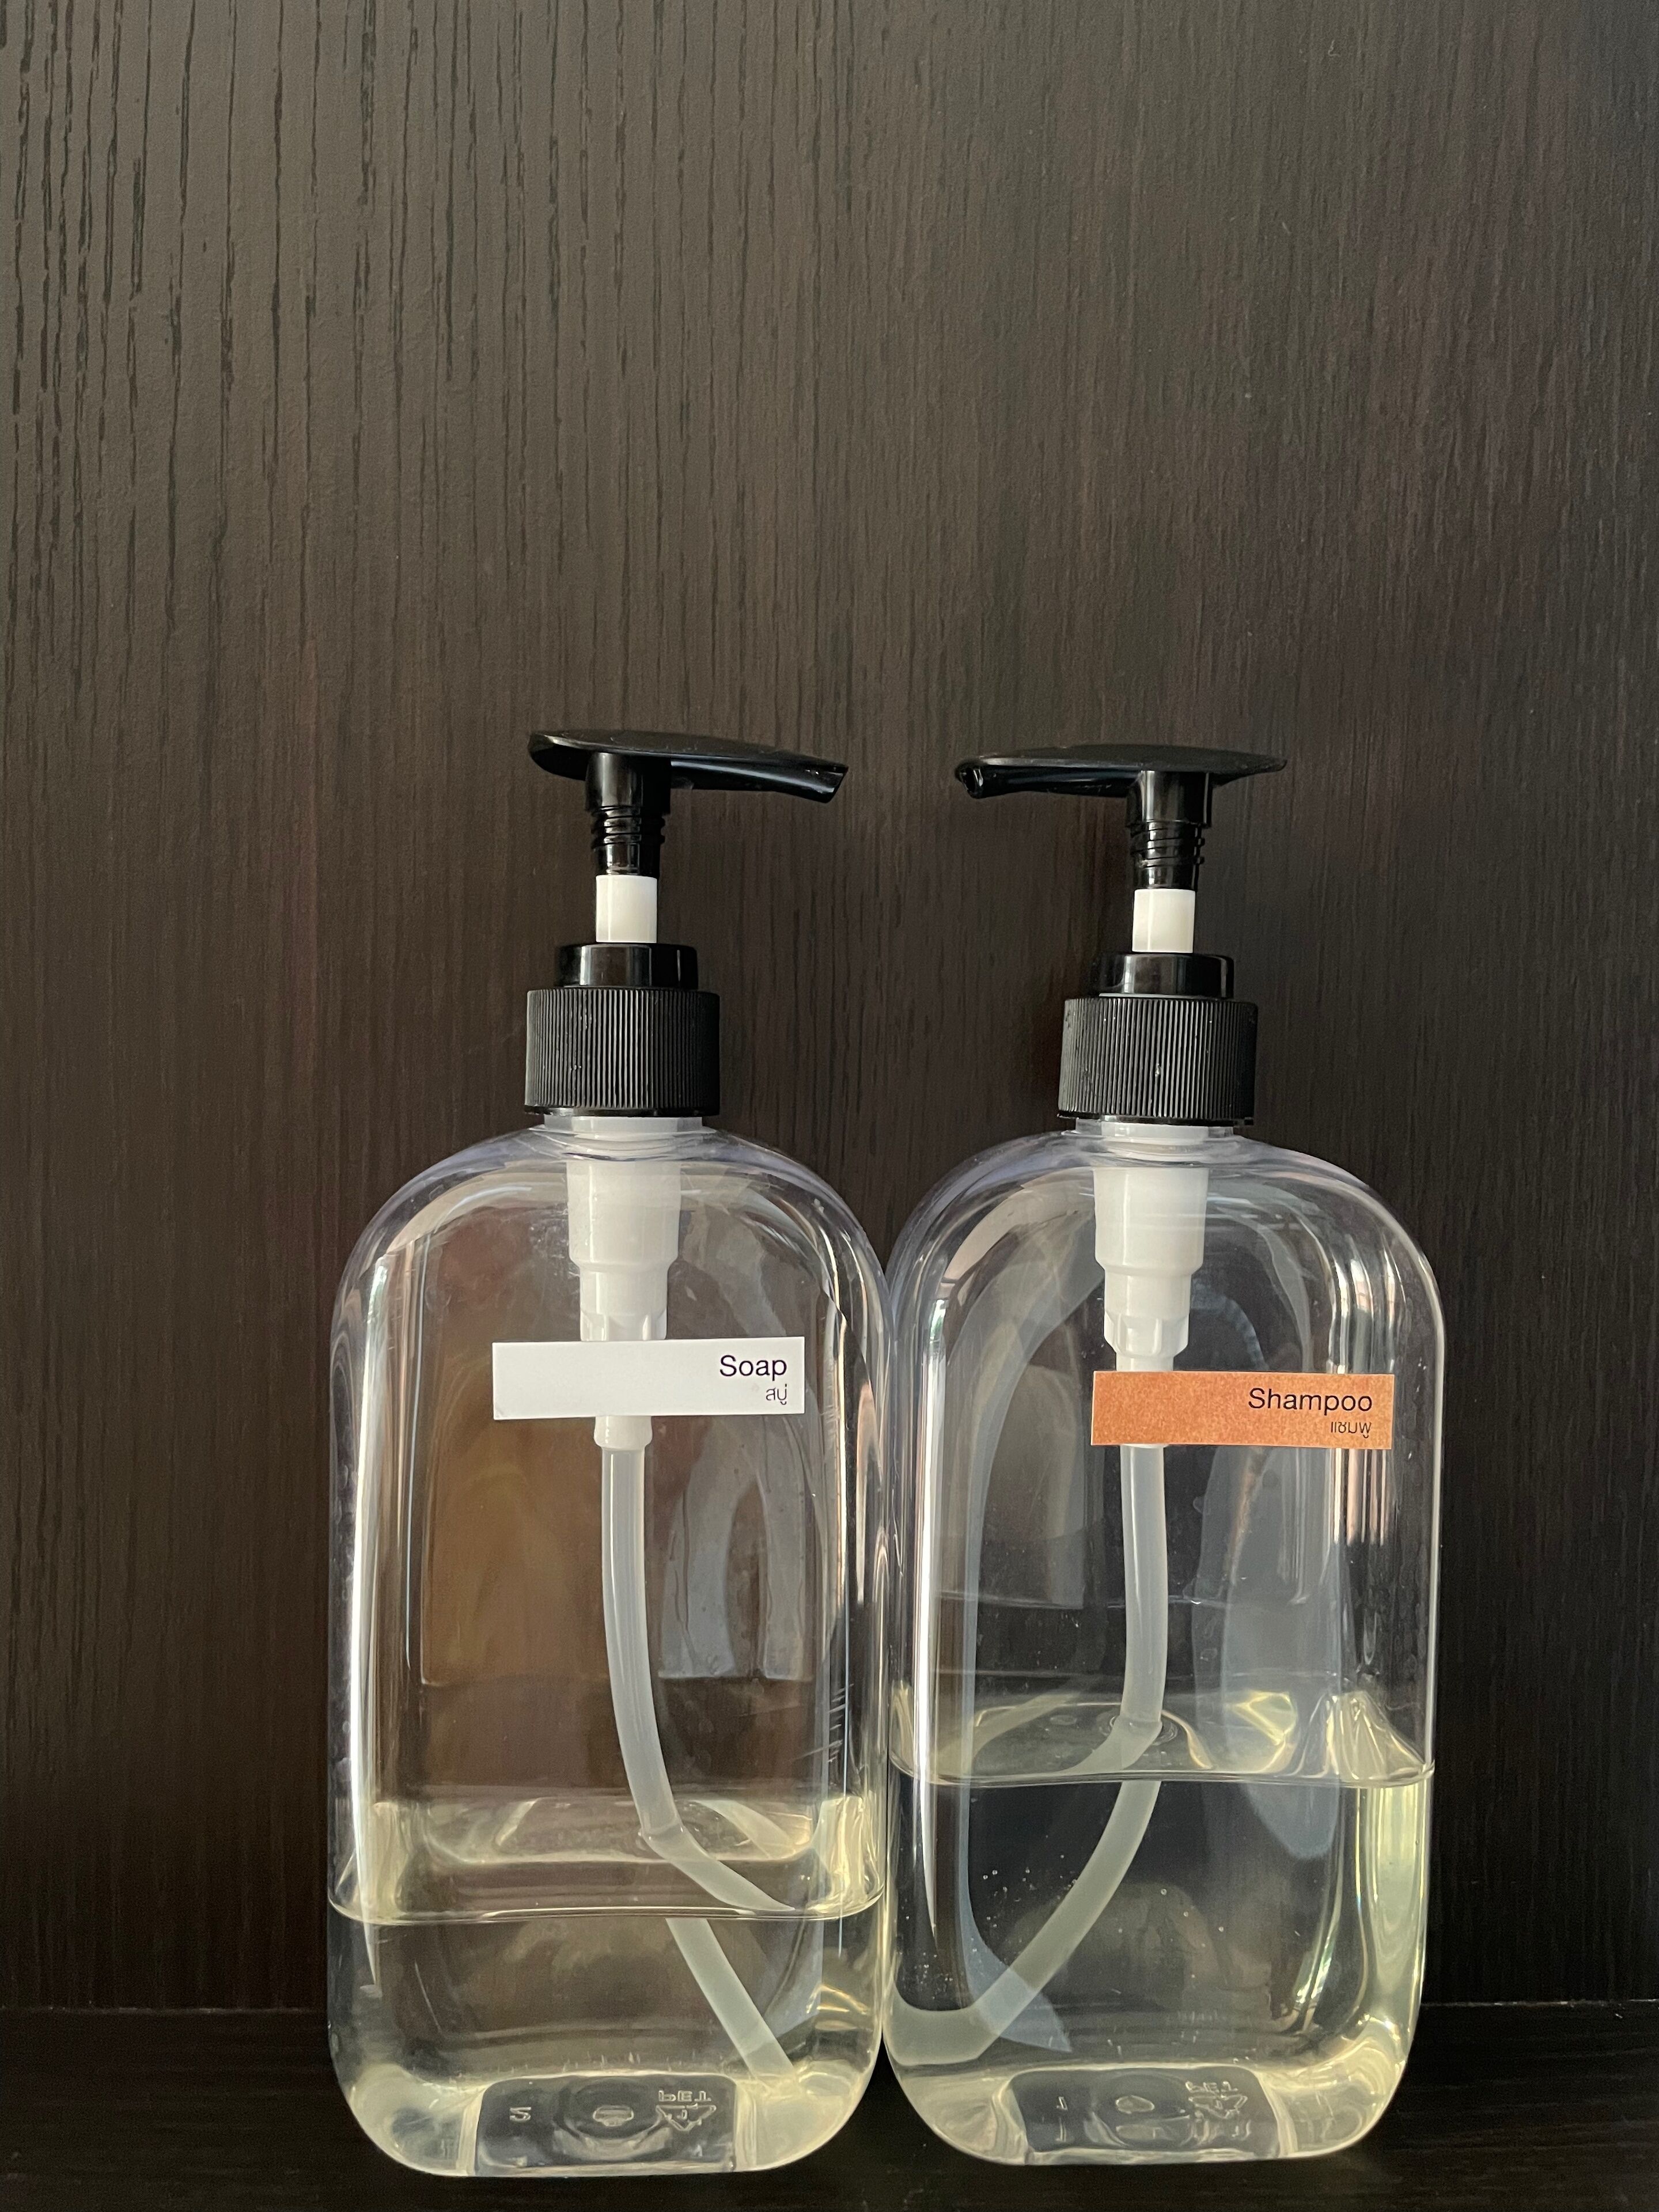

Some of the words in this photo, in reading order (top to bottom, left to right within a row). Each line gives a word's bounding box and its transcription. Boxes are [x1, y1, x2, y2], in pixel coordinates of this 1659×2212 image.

[720, 1354, 787, 1381] Soap
[766, 1383, 787, 1406] สบู่
[1248, 1387, 1373, 1416] Shampoo
[1330, 1421, 1372, 1439] แชมพู
